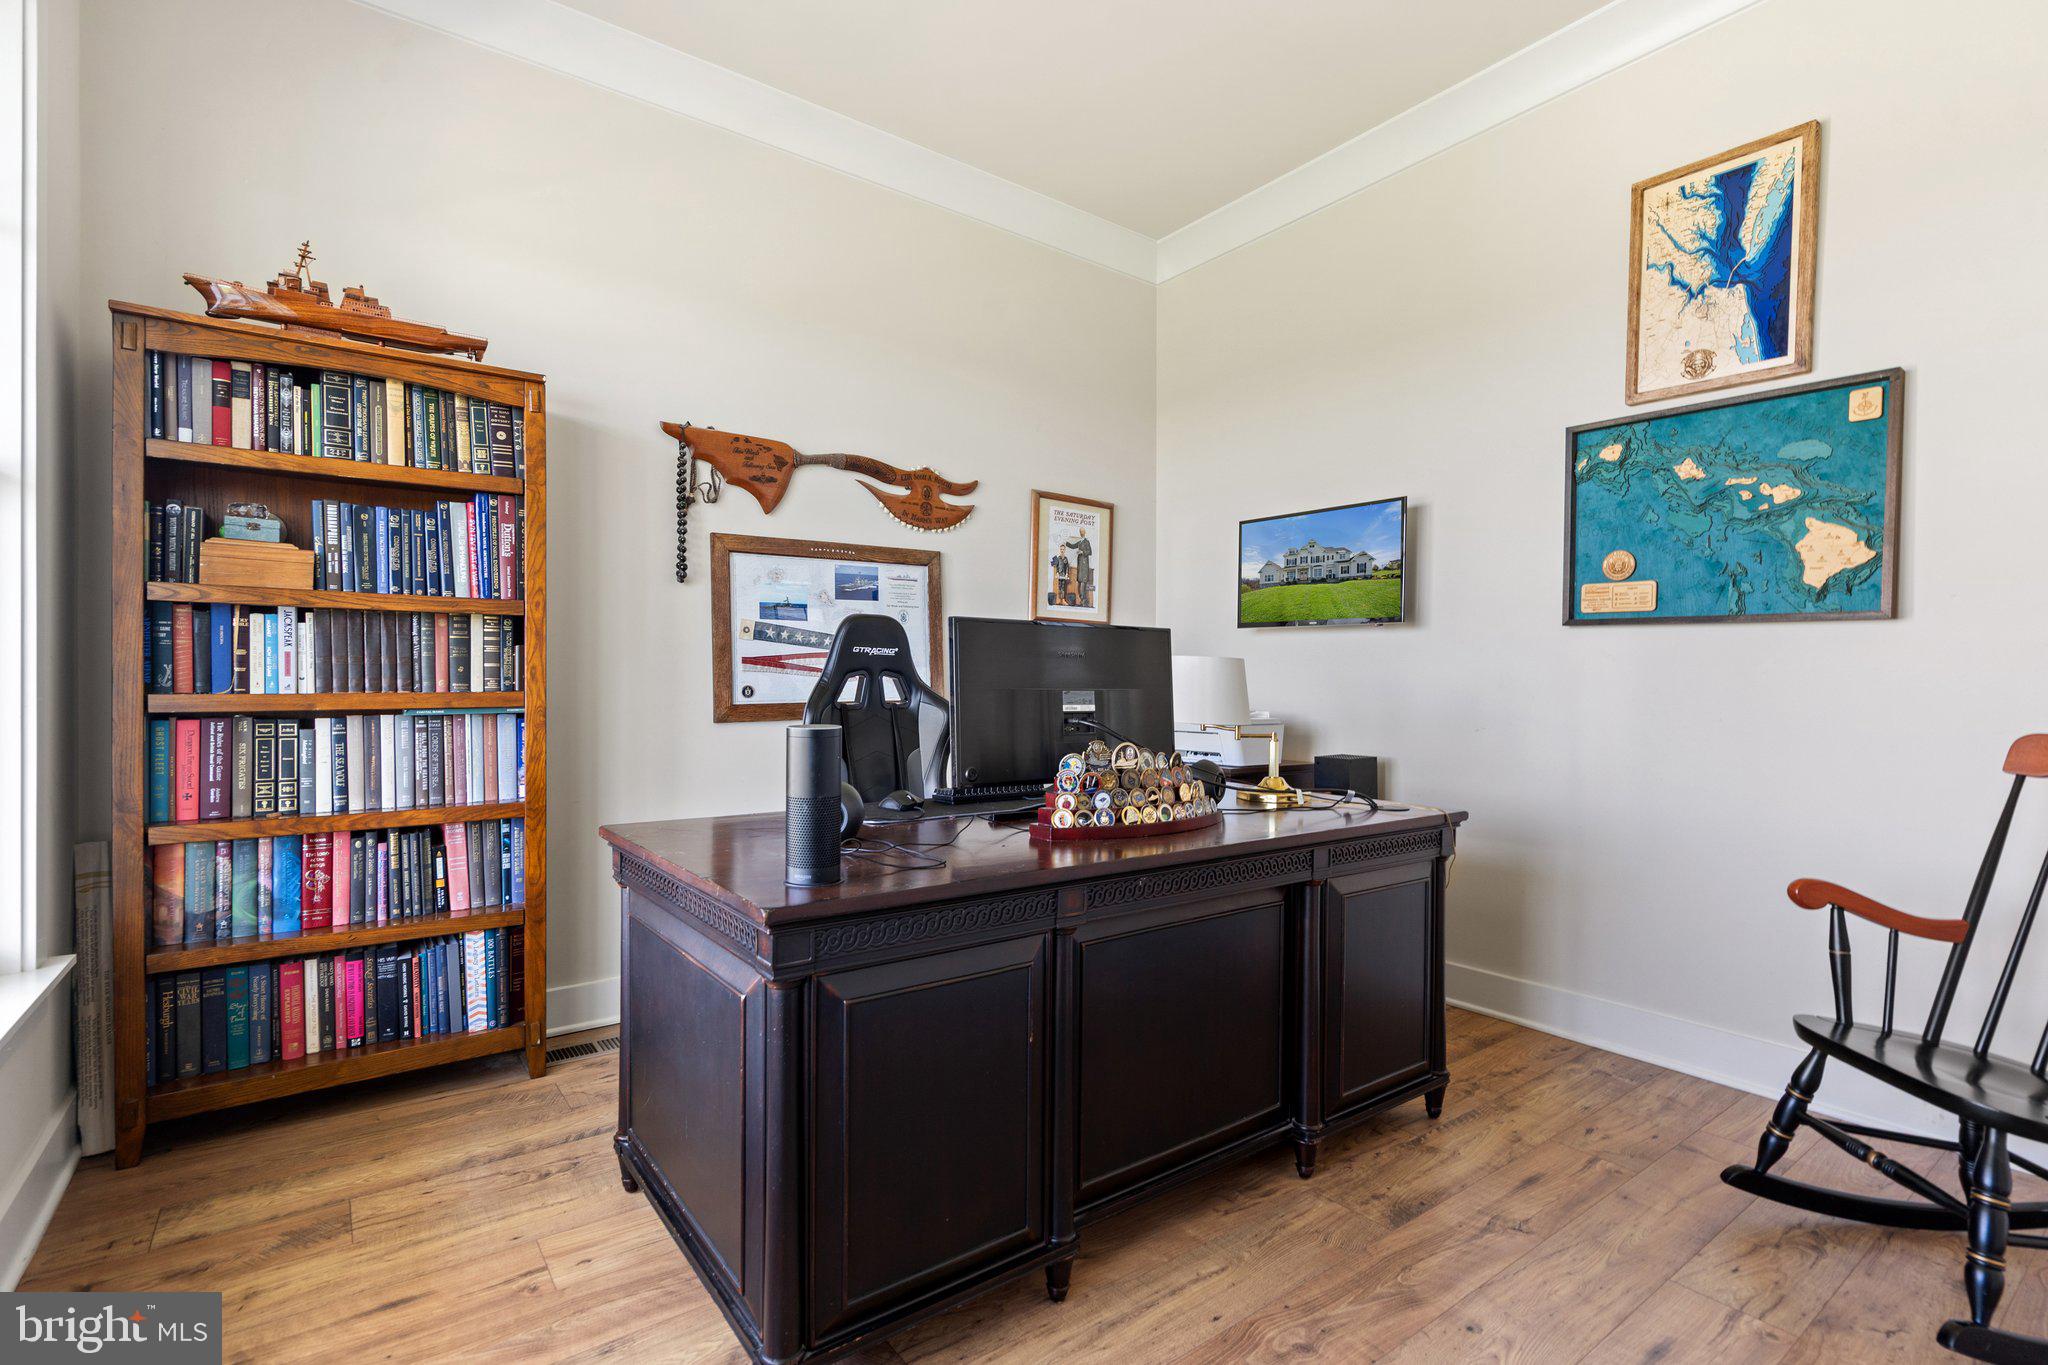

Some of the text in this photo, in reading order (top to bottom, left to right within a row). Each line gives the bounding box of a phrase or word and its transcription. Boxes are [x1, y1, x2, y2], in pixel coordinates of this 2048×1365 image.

[327, 504, 338, 545] INDIANAPOLIS
[1054, 516, 1094, 526] EVENING POST
[1066, 512, 1096, 520] SATURDAY
[502, 524, 514, 558] Dutton's
[284, 610, 293, 648] JACKSPEAK
[852, 646, 896, 656] GTRACING
[154, 726, 164, 776] GHOST FLEET
[178, 986, 200, 996] CIVIL
[180, 992, 197, 1000] WAR
[160, 991, 174, 1028] Hesburgh
[178, 998, 200, 1007] YEARS
[284, 989, 292, 1024] EXPLAINED
